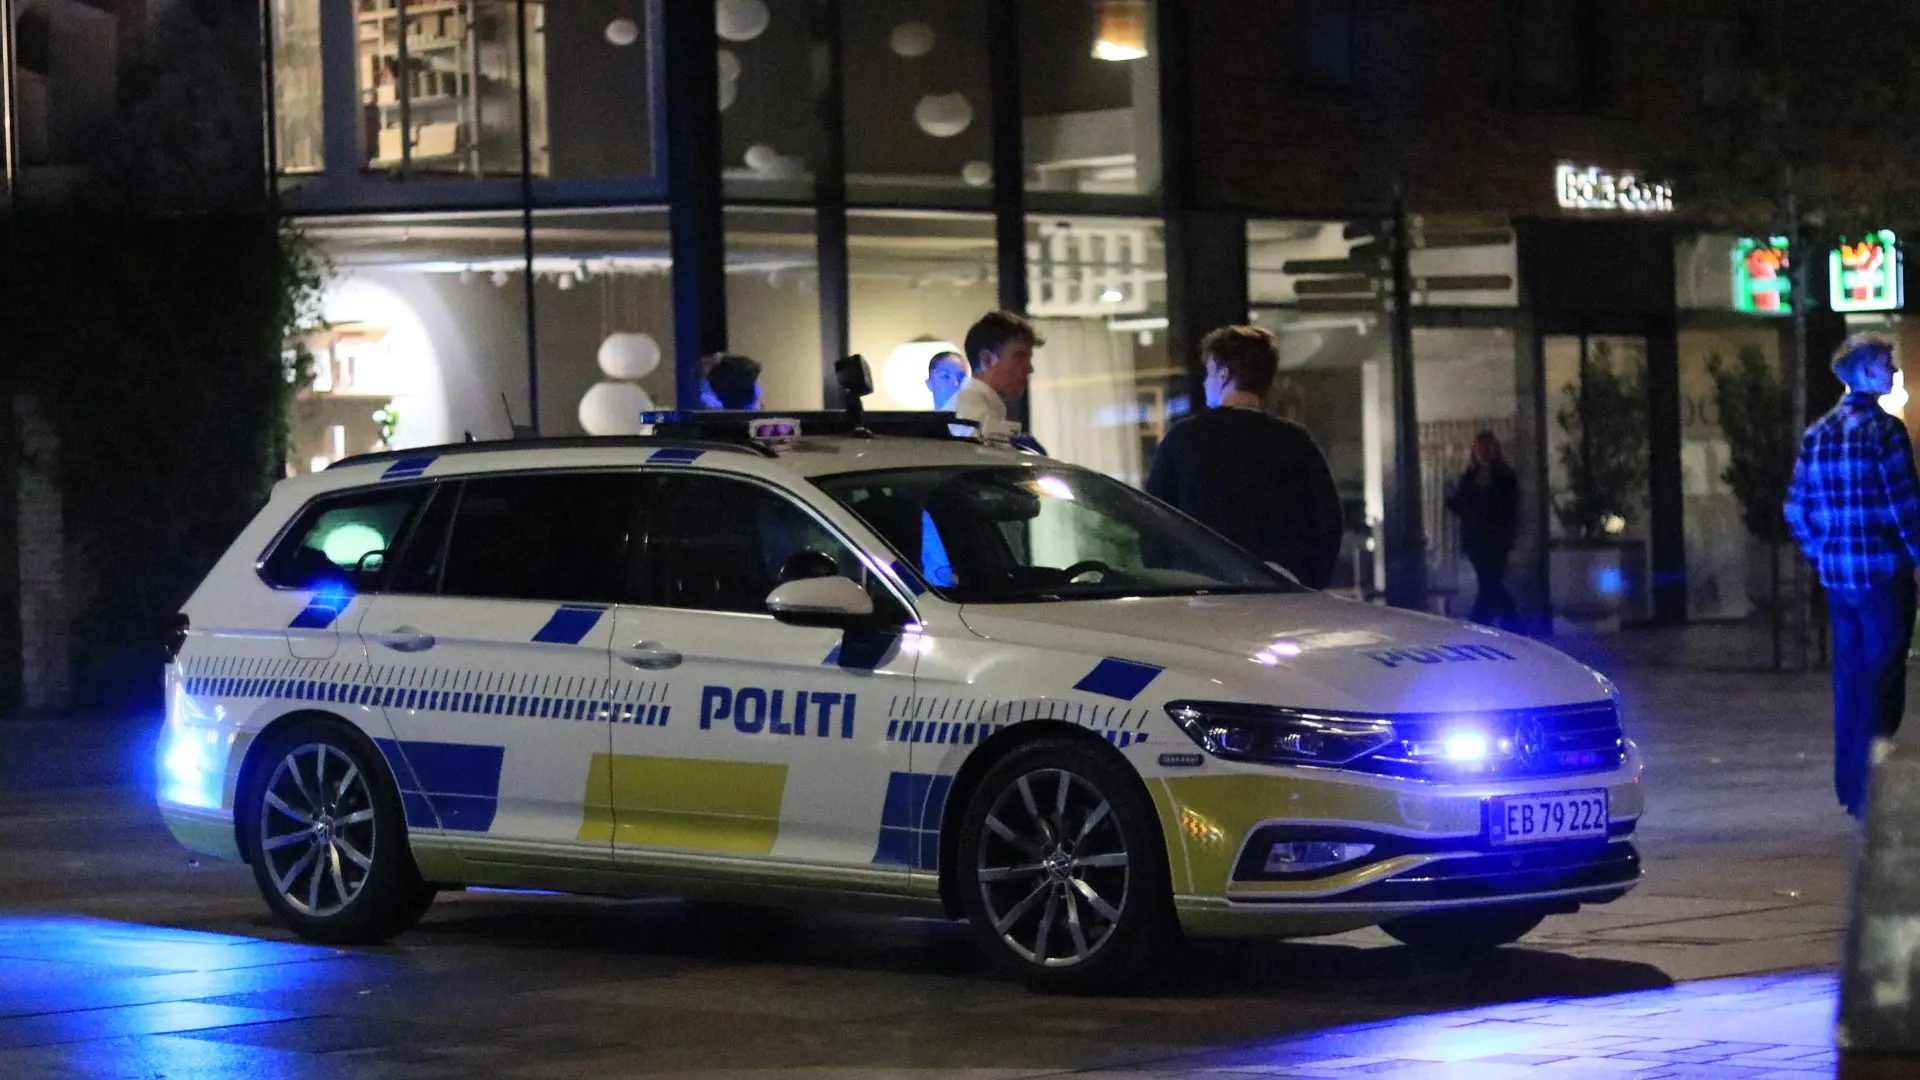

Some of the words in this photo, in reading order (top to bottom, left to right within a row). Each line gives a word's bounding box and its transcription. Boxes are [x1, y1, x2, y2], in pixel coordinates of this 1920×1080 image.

[700, 685, 857, 739] POLITI
[1507, 804, 1534, 835] EB
[1541, 802, 1564, 832] 79
[1568, 799, 1603, 831] 222
